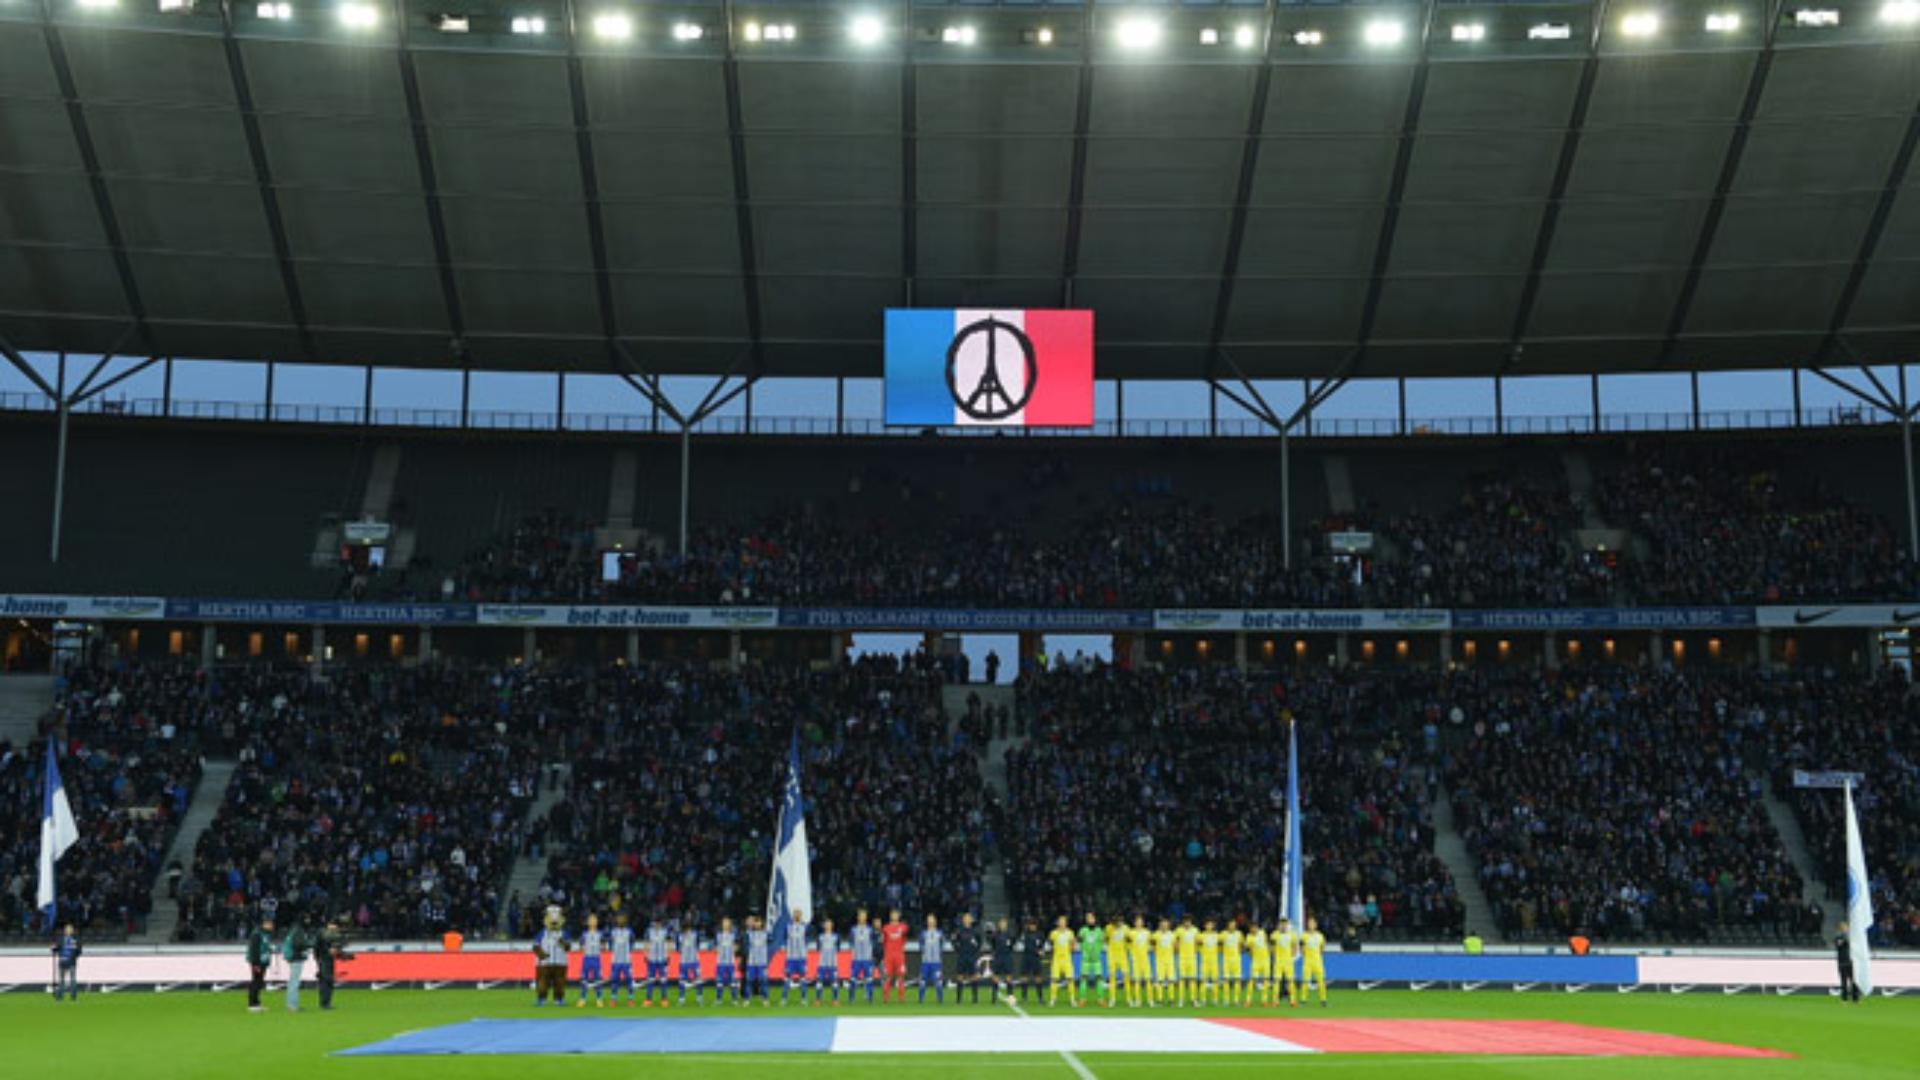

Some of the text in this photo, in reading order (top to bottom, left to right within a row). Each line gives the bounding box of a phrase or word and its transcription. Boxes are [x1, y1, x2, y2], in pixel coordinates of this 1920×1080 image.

[566, 608, 690, 625] bet-at-home
[934, 612, 969, 625] UND
[1241, 611, 1362, 628] bet-at-home
